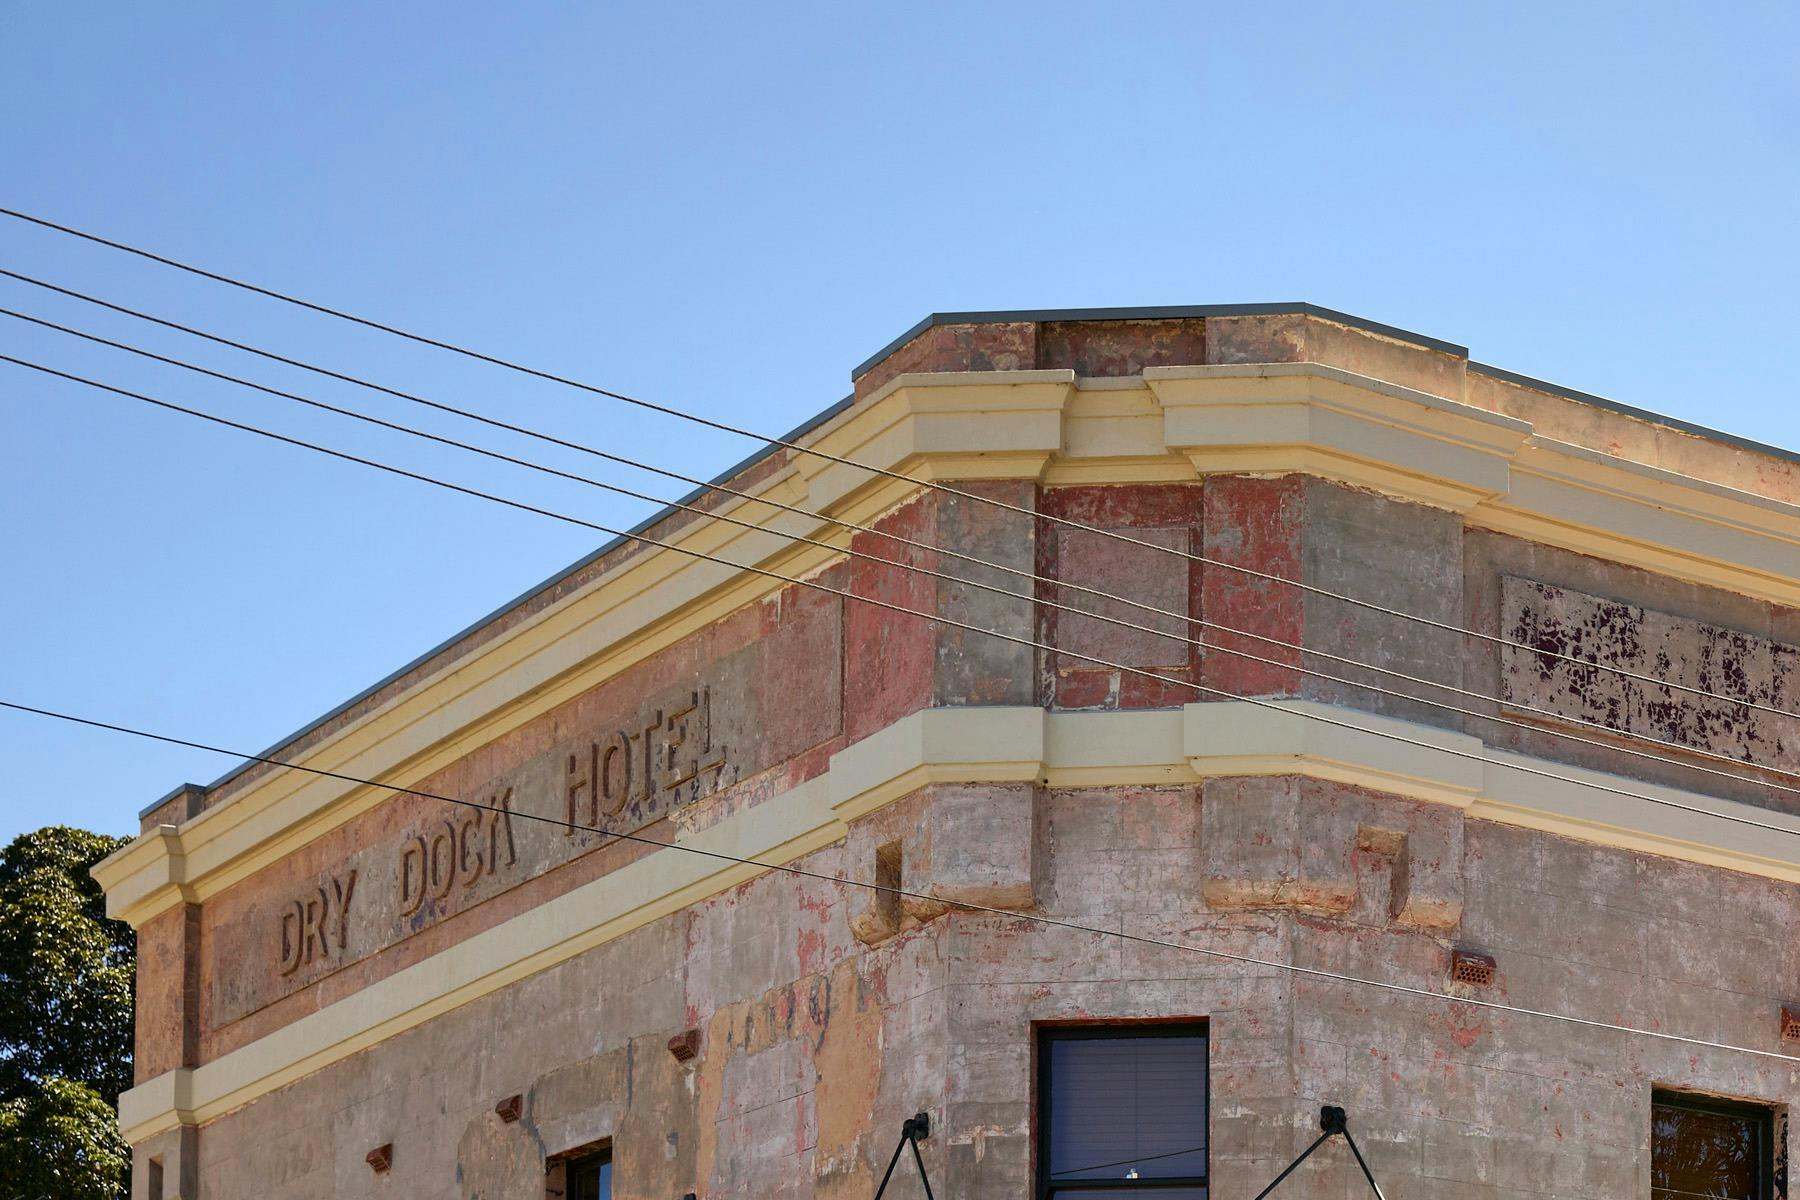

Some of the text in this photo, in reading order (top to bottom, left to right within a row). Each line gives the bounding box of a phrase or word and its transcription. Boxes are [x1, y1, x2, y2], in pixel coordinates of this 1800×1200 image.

[279, 684, 728, 977] DRY DOCK HOTEL
